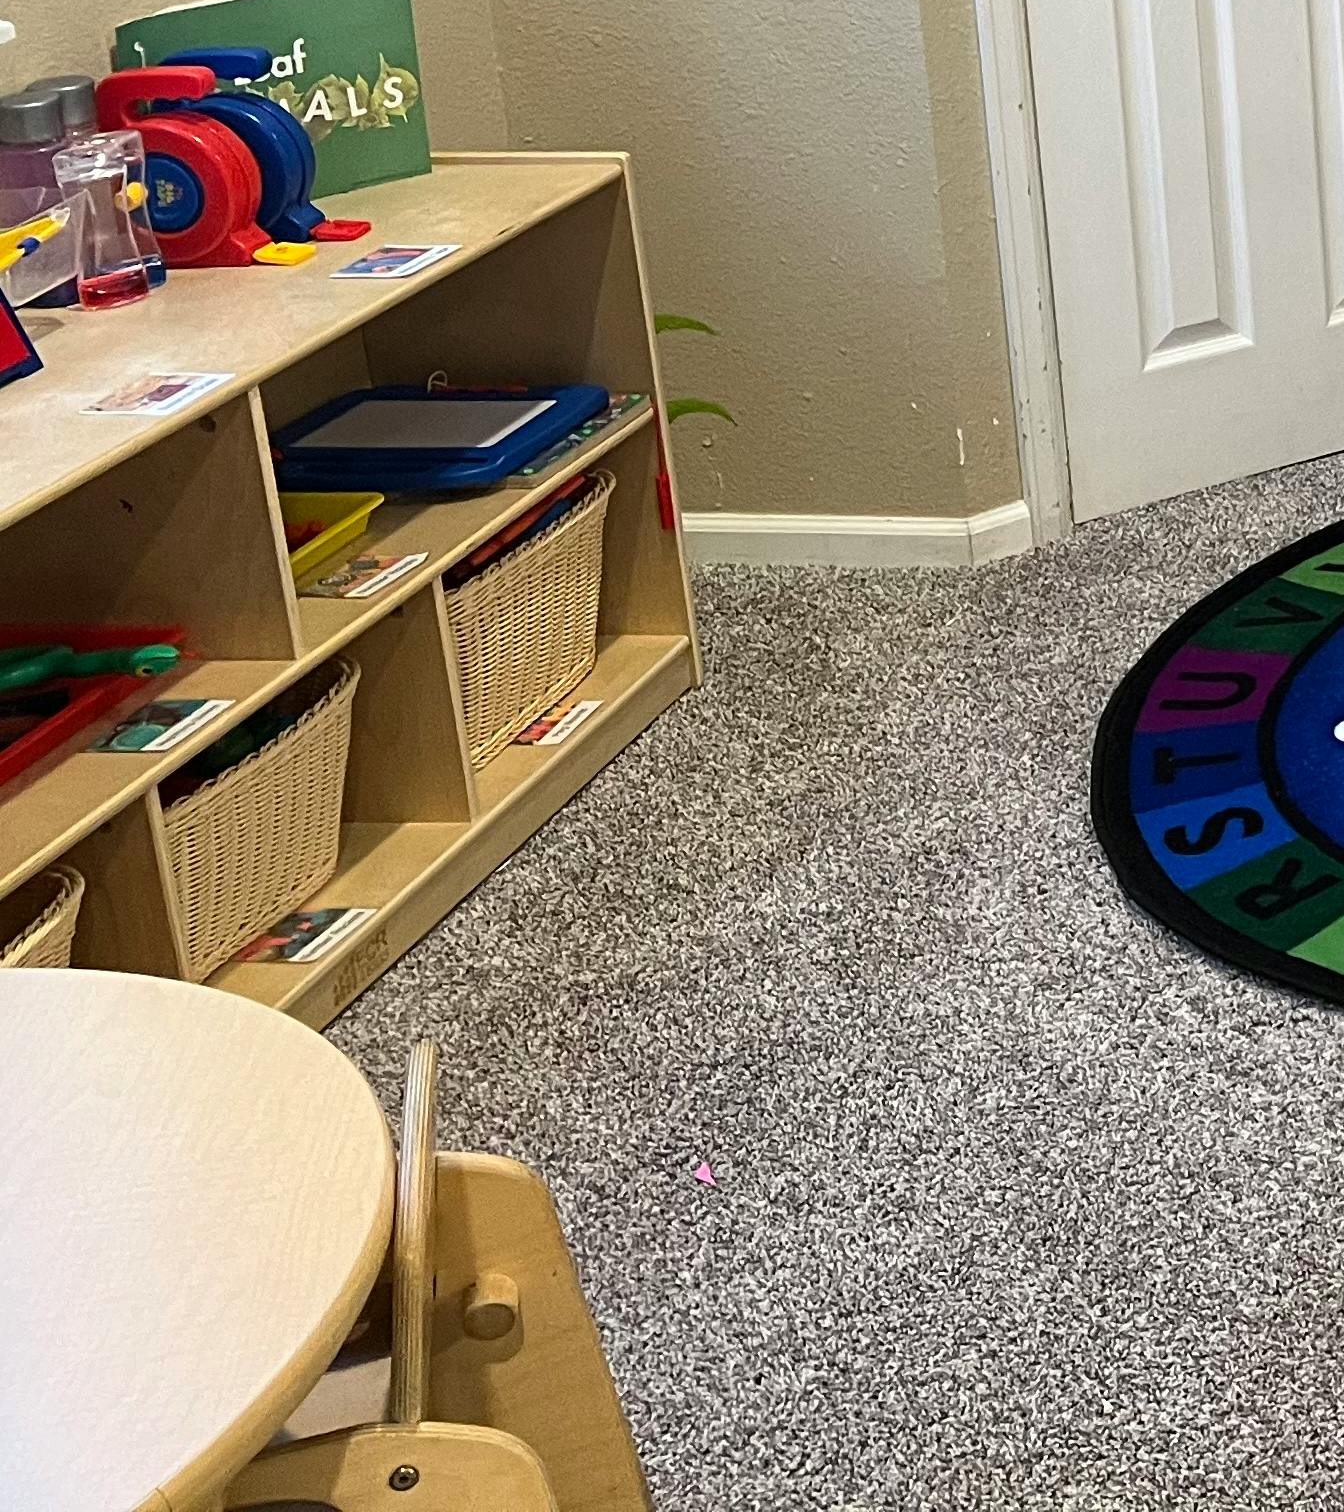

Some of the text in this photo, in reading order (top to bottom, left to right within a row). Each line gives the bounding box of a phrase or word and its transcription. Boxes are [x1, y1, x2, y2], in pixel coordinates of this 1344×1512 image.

[1234, 596, 1324, 629] V
[1159, 671, 1257, 712] U
[1153, 746, 1242, 784] T
[1164, 806, 1264, 856] S
[1235, 857, 1344, 921] R
